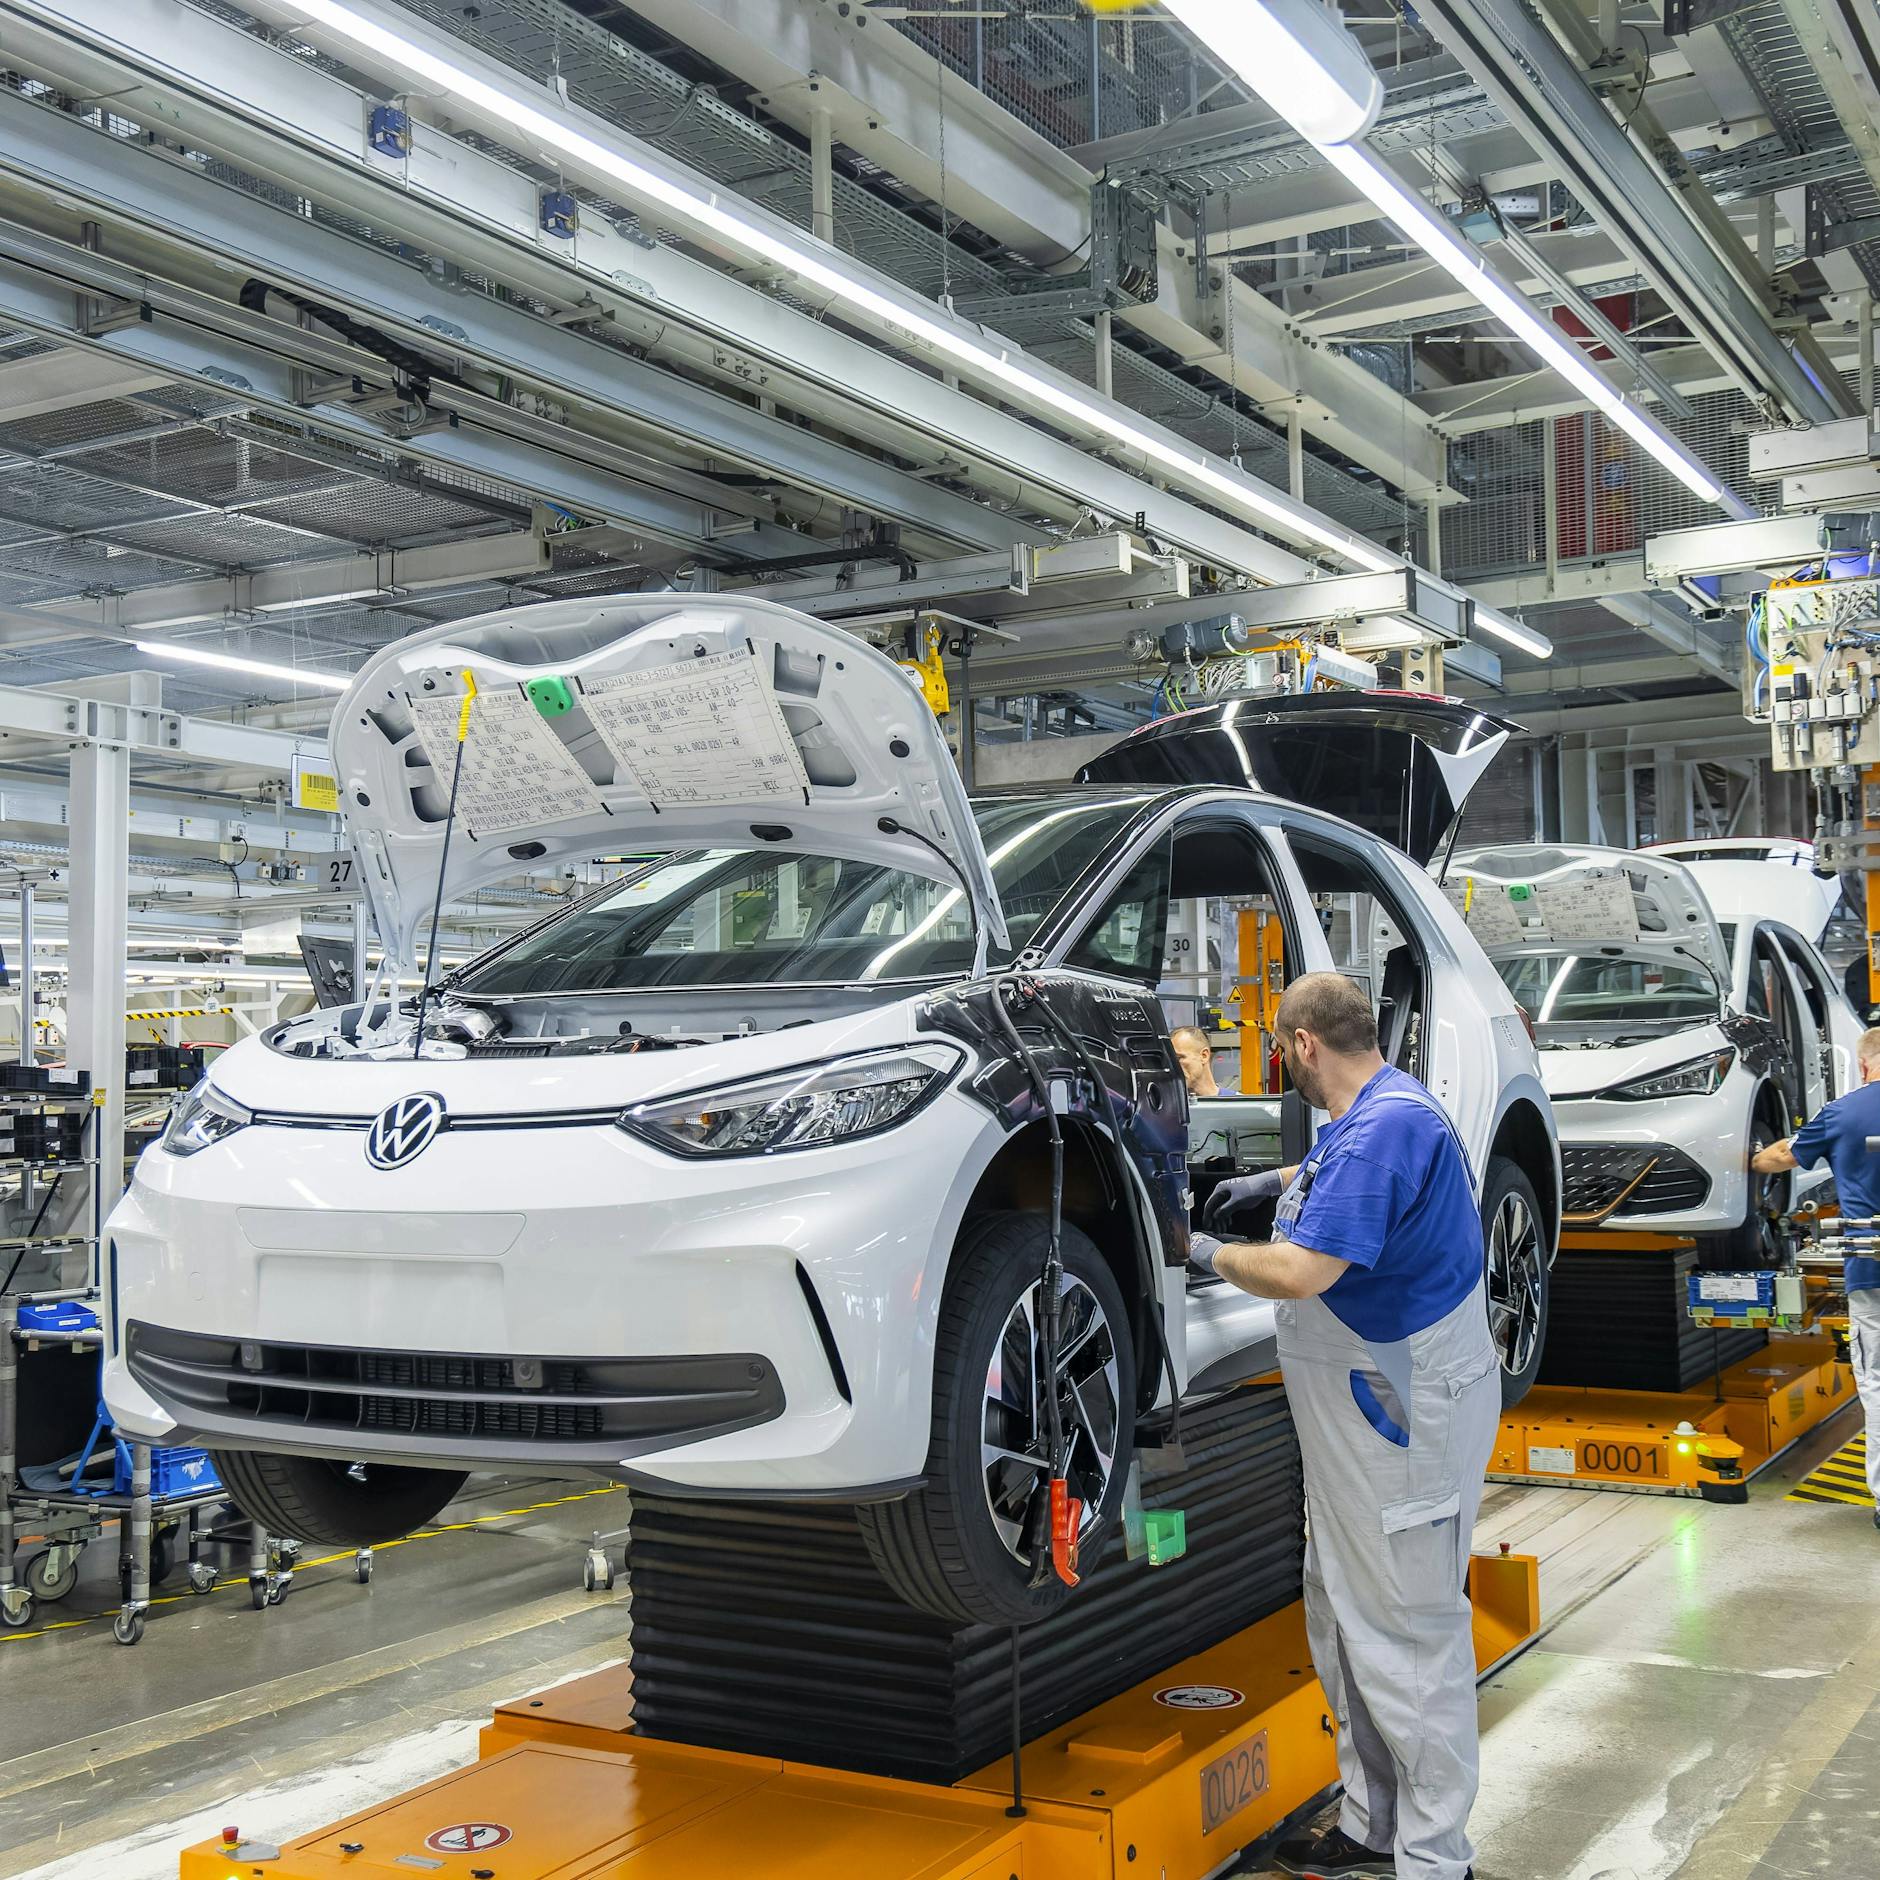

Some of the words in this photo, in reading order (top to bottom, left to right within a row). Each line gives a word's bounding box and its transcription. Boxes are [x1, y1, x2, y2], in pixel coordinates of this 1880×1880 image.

[330, 861, 352, 882] 27
[1172, 939, 1190, 952] 30
[1583, 1443, 1658, 1474] 0001
[1207, 1741, 1265, 1824] 0026
